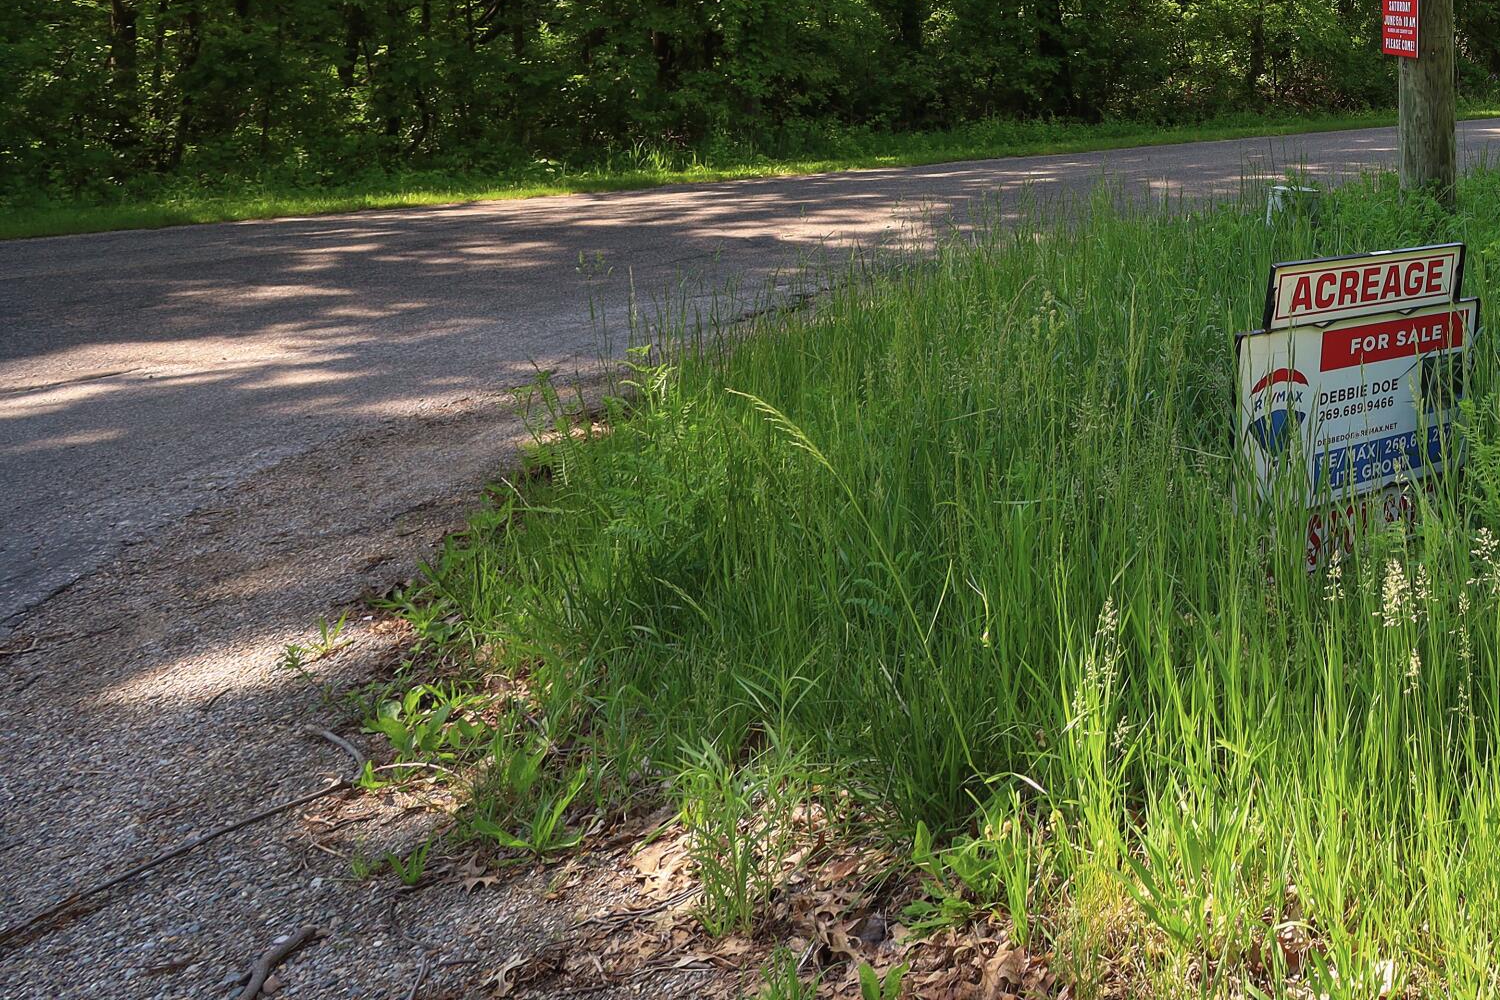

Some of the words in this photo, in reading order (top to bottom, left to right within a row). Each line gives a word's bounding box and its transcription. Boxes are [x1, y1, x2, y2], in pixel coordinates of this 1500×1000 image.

[1388, 0, 1411, 13] SATURDAY
[1384, 15, 1395, 26] JUNE
[1409, 16, 1416, 28] AM
[1385, 37, 1401, 50] PLEASE
[1291, 259, 1445, 313] ACREAGE
[1350, 332, 1390, 355] FOR
[1396, 324, 1443, 347] SALE
[1254, 390, 1303, 412] R/MAX
[1319, 384, 1368, 406] DEBBIE
[1372, 378, 1399, 395] DOE
[1324, 467, 1358, 488] LITE
